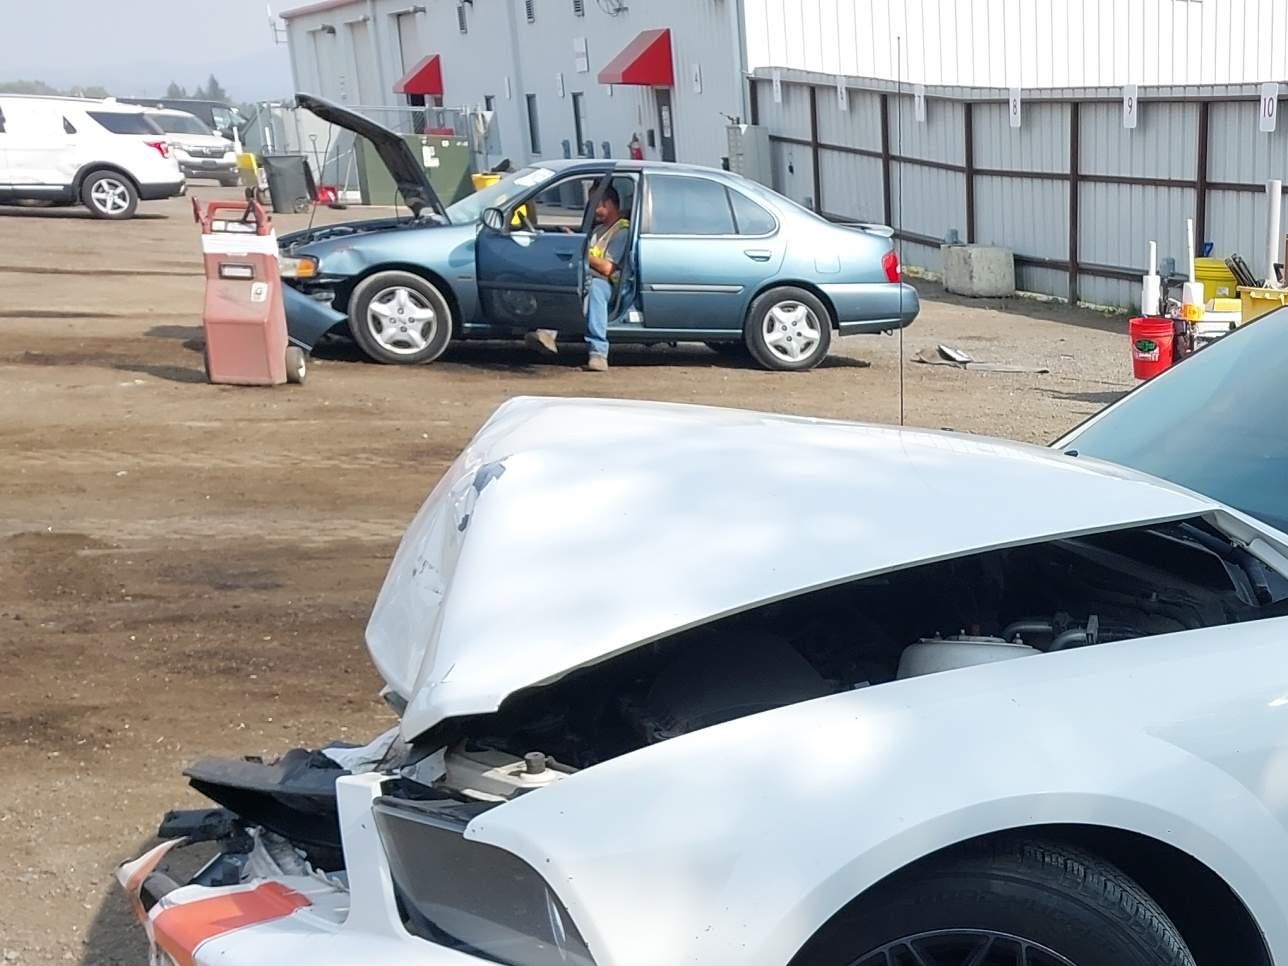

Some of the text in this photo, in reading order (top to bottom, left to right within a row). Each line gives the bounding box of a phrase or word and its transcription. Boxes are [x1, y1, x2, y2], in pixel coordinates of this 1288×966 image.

[1012, 99, 1018, 116] 8
[1126, 98, 1133, 116] 9
[1263, 97, 1275, 118] 10
